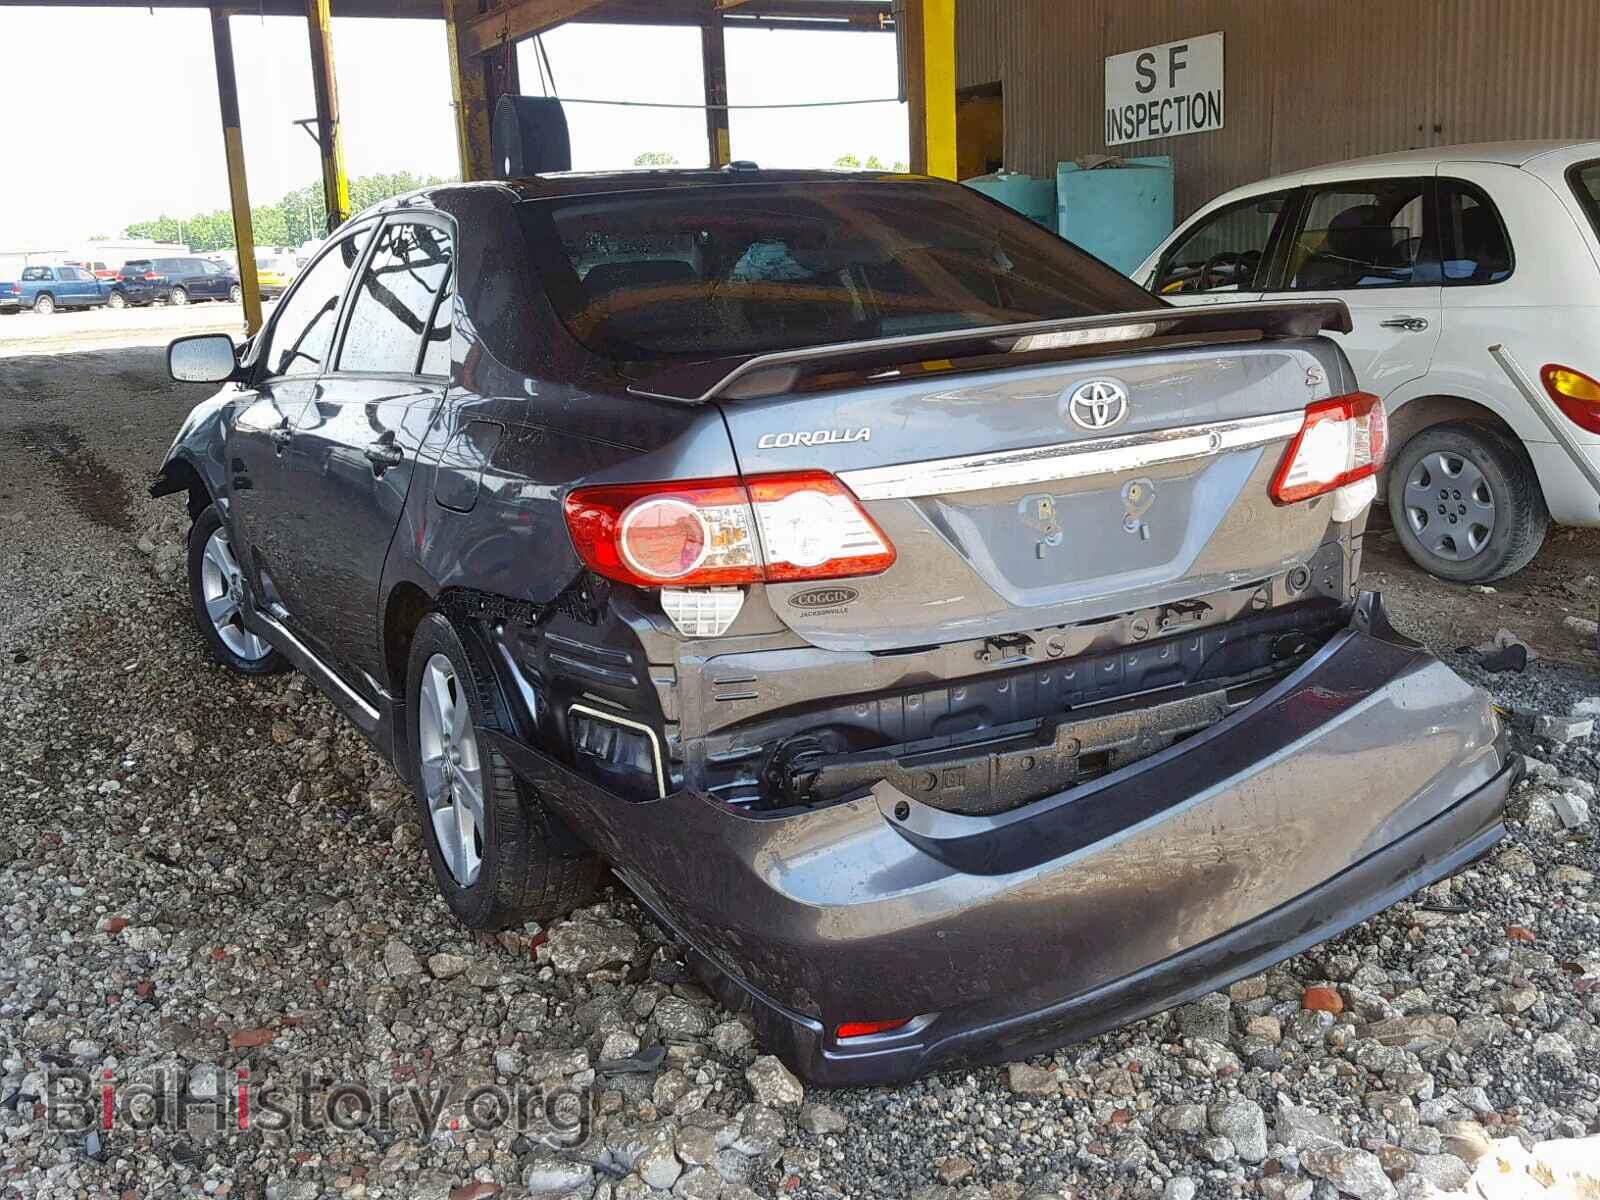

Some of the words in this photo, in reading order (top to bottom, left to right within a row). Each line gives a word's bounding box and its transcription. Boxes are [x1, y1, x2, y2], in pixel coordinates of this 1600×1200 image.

[1135, 52, 1157, 94] S
[1169, 44, 1188, 88] F
[1107, 89, 1221, 143] INSPECTION
[1305, 366, 1322, 386] S
[757, 427, 871, 449] COROLLA
[798, 590, 849, 605] COGGIN
[800, 607, 849, 618] JACKSONVILLE
